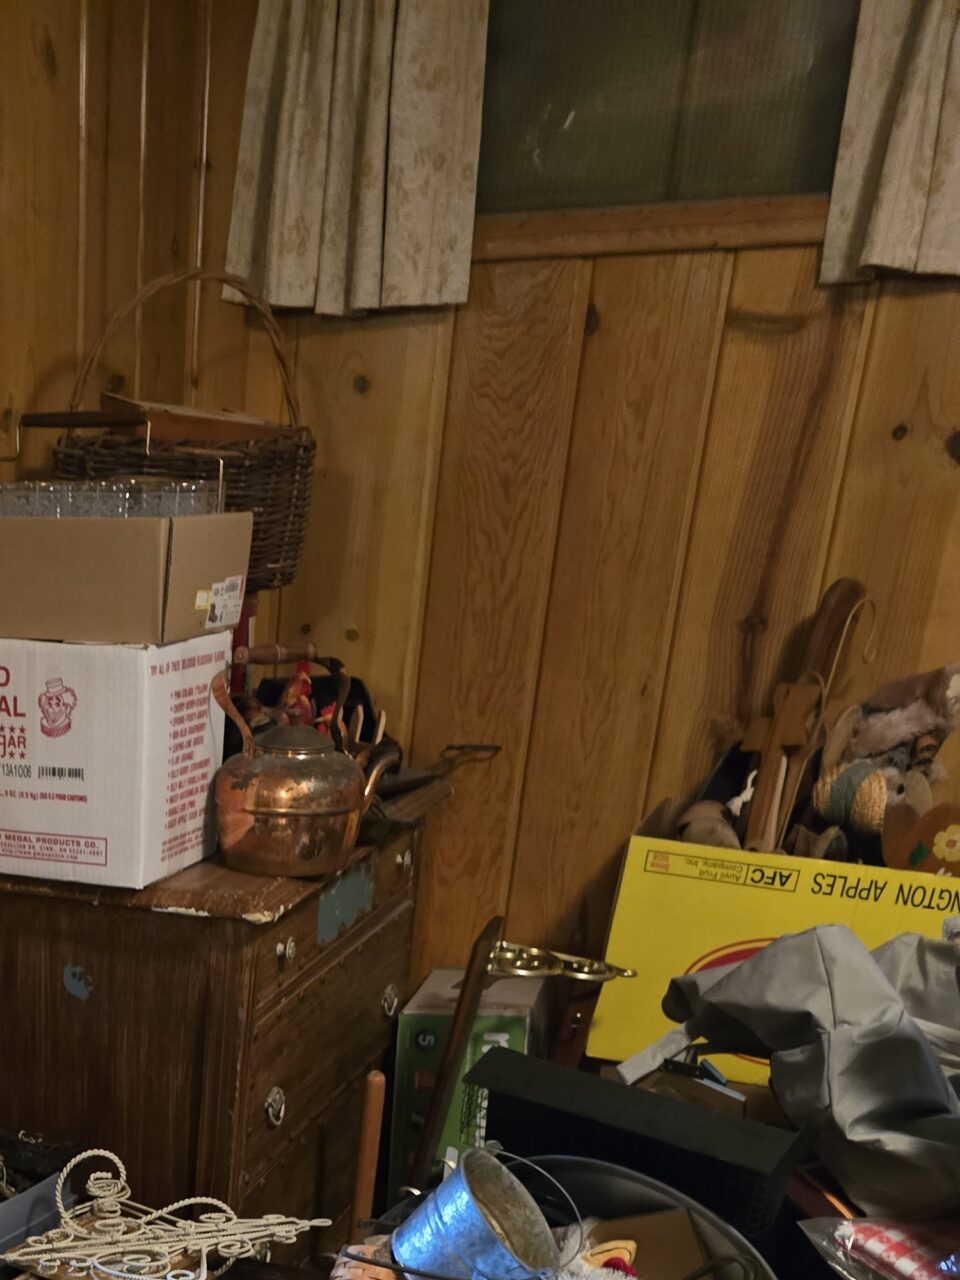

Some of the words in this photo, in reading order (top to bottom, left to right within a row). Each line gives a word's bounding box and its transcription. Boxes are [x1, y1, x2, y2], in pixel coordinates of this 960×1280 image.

[4, 834, 33, 843] MEDAL
[36, 837, 81, 847] PRODUCTS
[84, 841, 100, 849] CO.
[698, 868, 720, 879] Fruit
[750, 867, 793, 888] AFC
[811, 872, 888, 903] APPLES
[418, 1032, 436, 1047] 5
